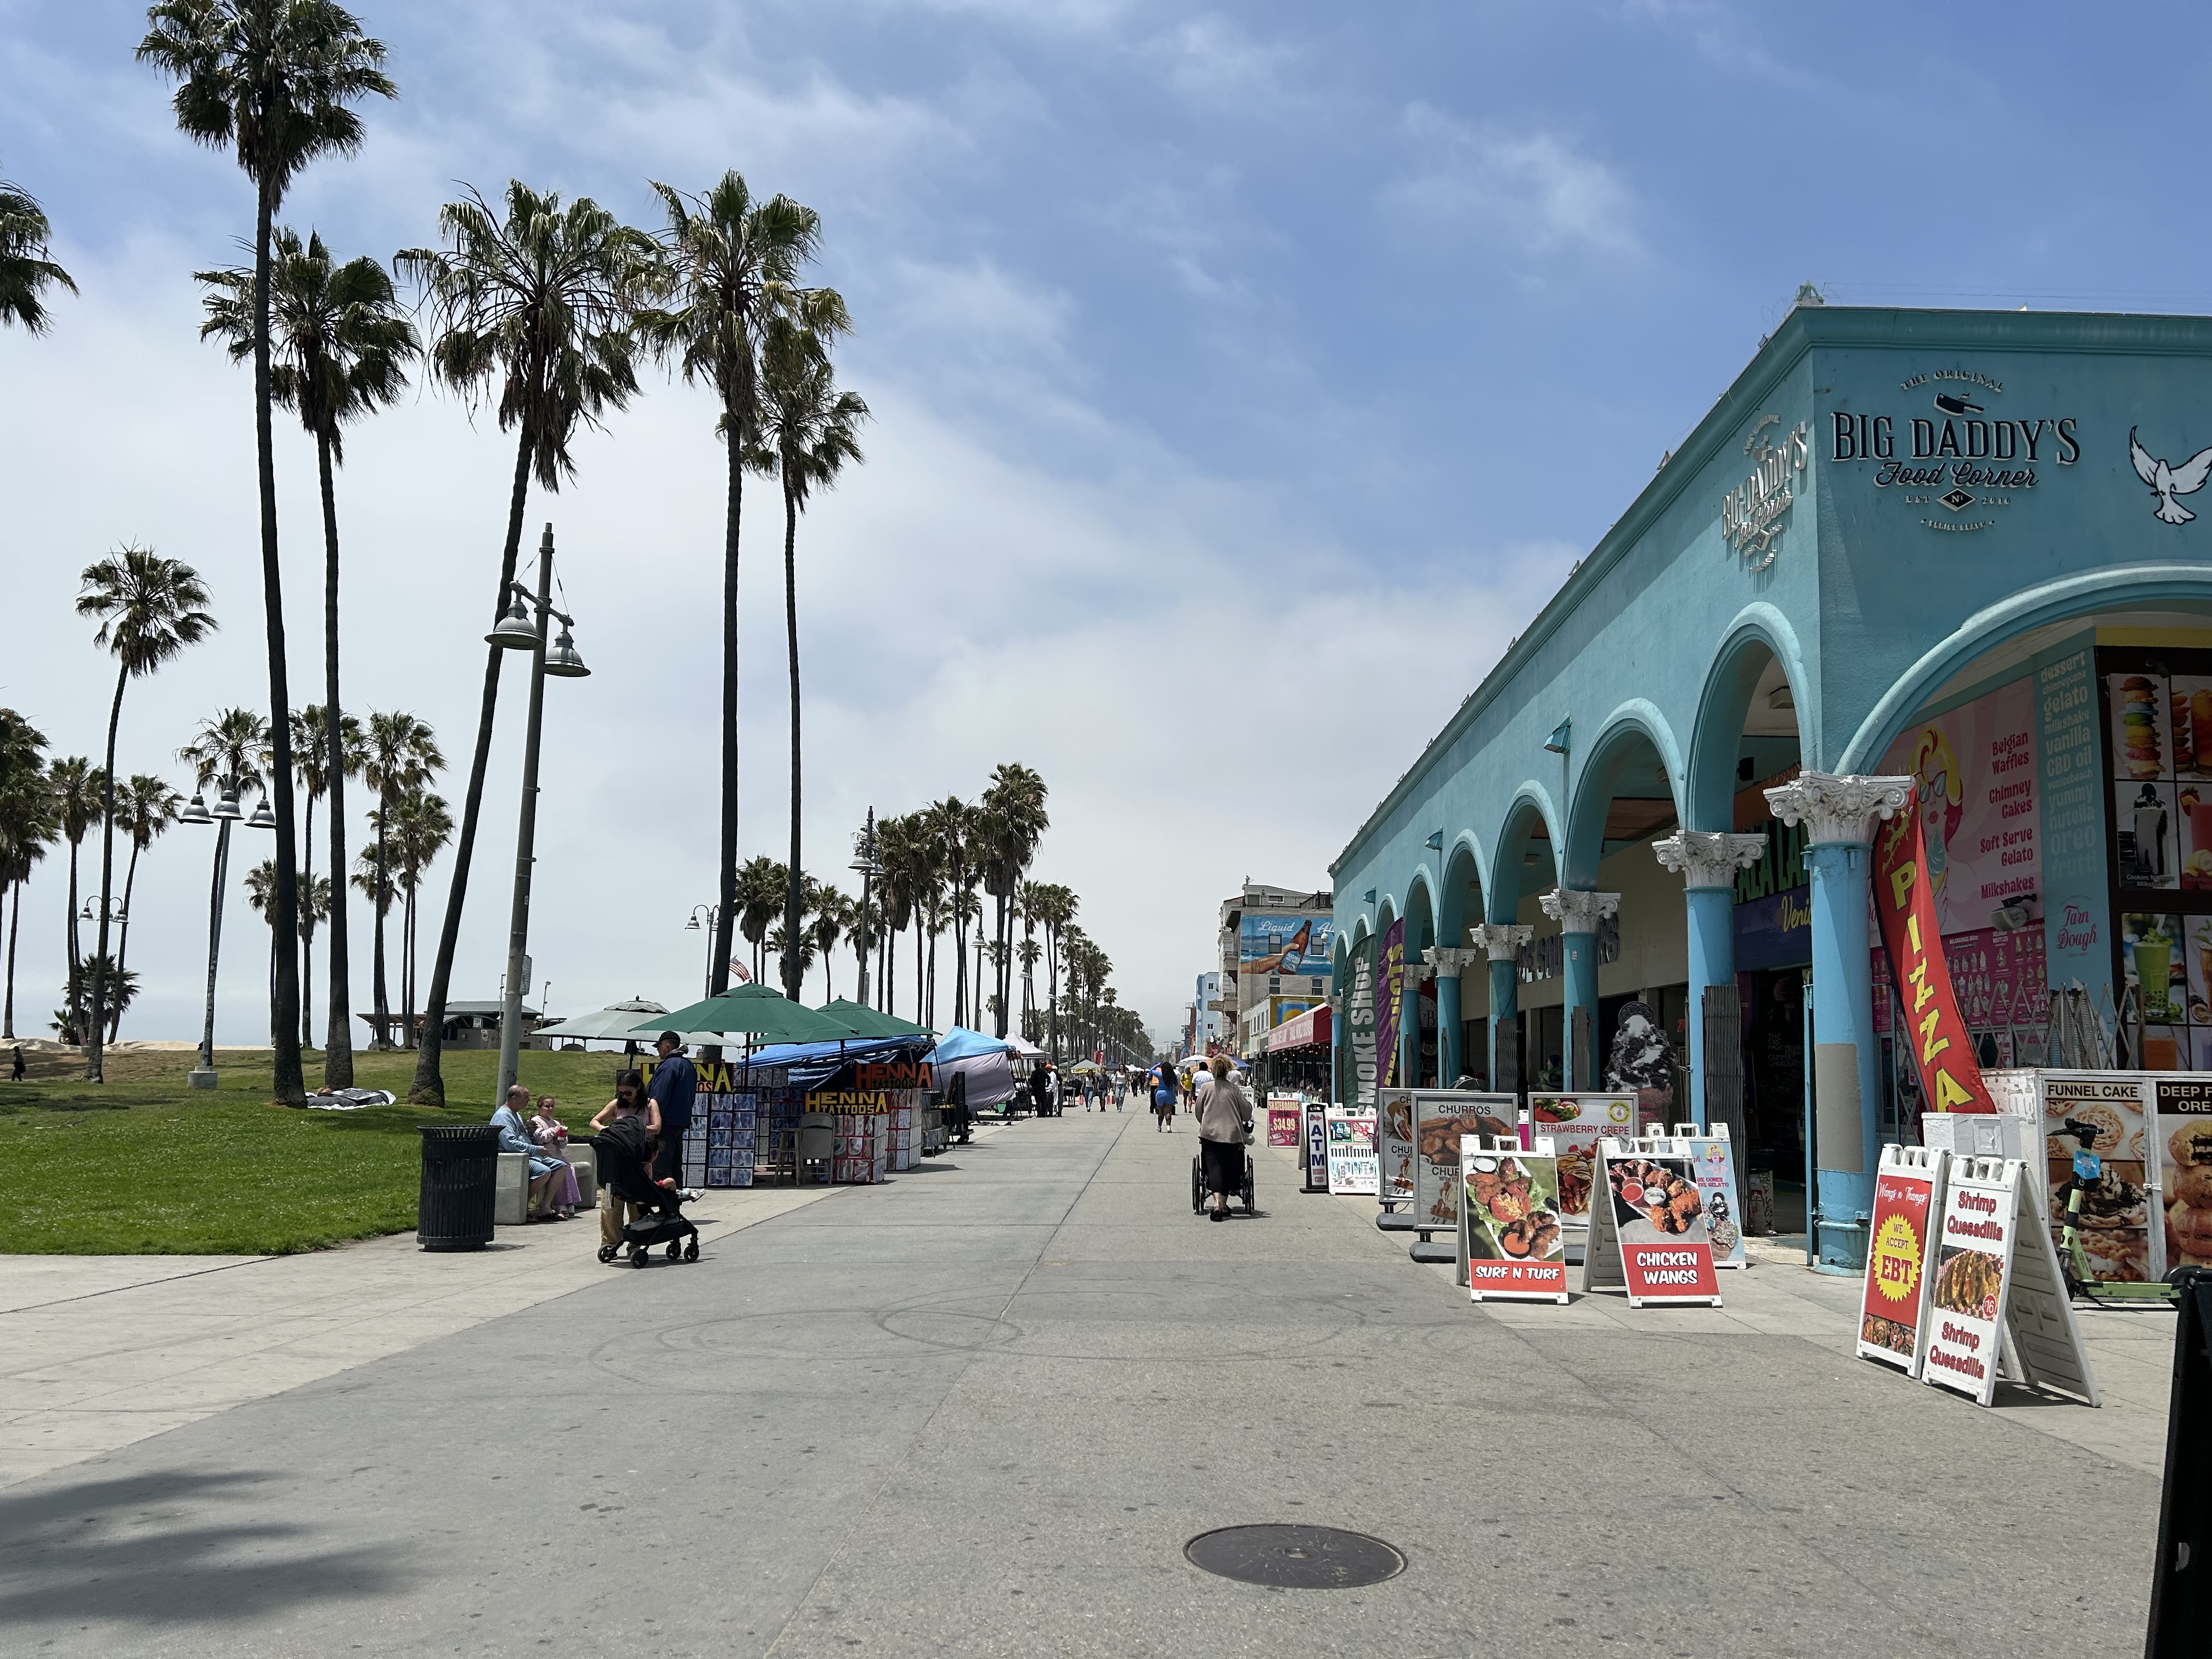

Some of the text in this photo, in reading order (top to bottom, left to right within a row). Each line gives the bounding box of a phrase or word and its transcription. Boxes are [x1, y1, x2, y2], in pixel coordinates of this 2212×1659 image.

[1900, 369, 2004, 393] THE ORIGINAL
[1831, 411, 1895, 462] BIG
[1910, 418, 2081, 465] DADDY'S
[1873, 461, 2040, 488] Food Corner
[1905, 495, 1930, 504] EST
[1982, 496, 2011, 505] 2016
[2041, 651, 2086, 683] dessert
[2044, 686, 2088, 722] gelato
[2045, 709, 2090, 735] milkshake
[1992, 731, 2028, 757] Belgian
[2046, 725, 2091, 755] vanilla
[1992, 751, 2029, 775] Waffles
[2047, 745, 2092, 777] CBD oil
[1989, 780, 2031, 804] Chimney
[2049, 783, 2094, 814] yummy
[2002, 799, 2032, 819] Cakes
[2050, 804, 2095, 831] nutella
[1980, 828, 2033, 854] Soft Serve
[2050, 825, 2096, 856] oreo
[2001, 848, 2034, 867] Gelato
[1980, 876, 2034, 899] Milkshakes
[1782, 895, 1812, 933] Veni
[1257, 921, 1295, 934] Liquid
[2057, 923, 2098, 951] Dough
[1351, 956, 1374, 1026] SHOP
[1891, 859, 1975, 1113] PIZZA
[856, 1063, 932, 1088] HENNA
[805, 1092, 888, 1114] HENNA
[2048, 1085, 2138, 1098] FUNNEL CAKE
[2160, 1086, 2200, 1097] DEEP
[821, 1105, 874, 1114] TATTOOS
[1268, 1101, 1299, 1111] SKATEBOARDS
[1438, 1104, 1491, 1115] CHURROS
[2178, 1101, 2212, 1111] ORE
[1273, 1118, 1295, 1131] $34.99
[1541, 1124, 1630, 1135] STRAWBERRY CREPE
[1311, 1124, 1325, 1166] ATM
[1958, 1190, 1996, 1217] Shrimp
[1893, 1223, 1903, 1234] WE
[1948, 1215, 2003, 1242] Quesadilla
[1886, 1237, 1909, 1250] ACCEPT
[1637, 1250, 1699, 1268] CHICKEN
[1881, 1254, 1913, 1285] EBT
[1475, 1265, 1560, 1282] SURF N TURF
[1643, 1268, 1699, 1286] WANGS
[1942, 1321, 1980, 1353] Shrimp
[1930, 1345, 1984, 1380] Quesadilla
